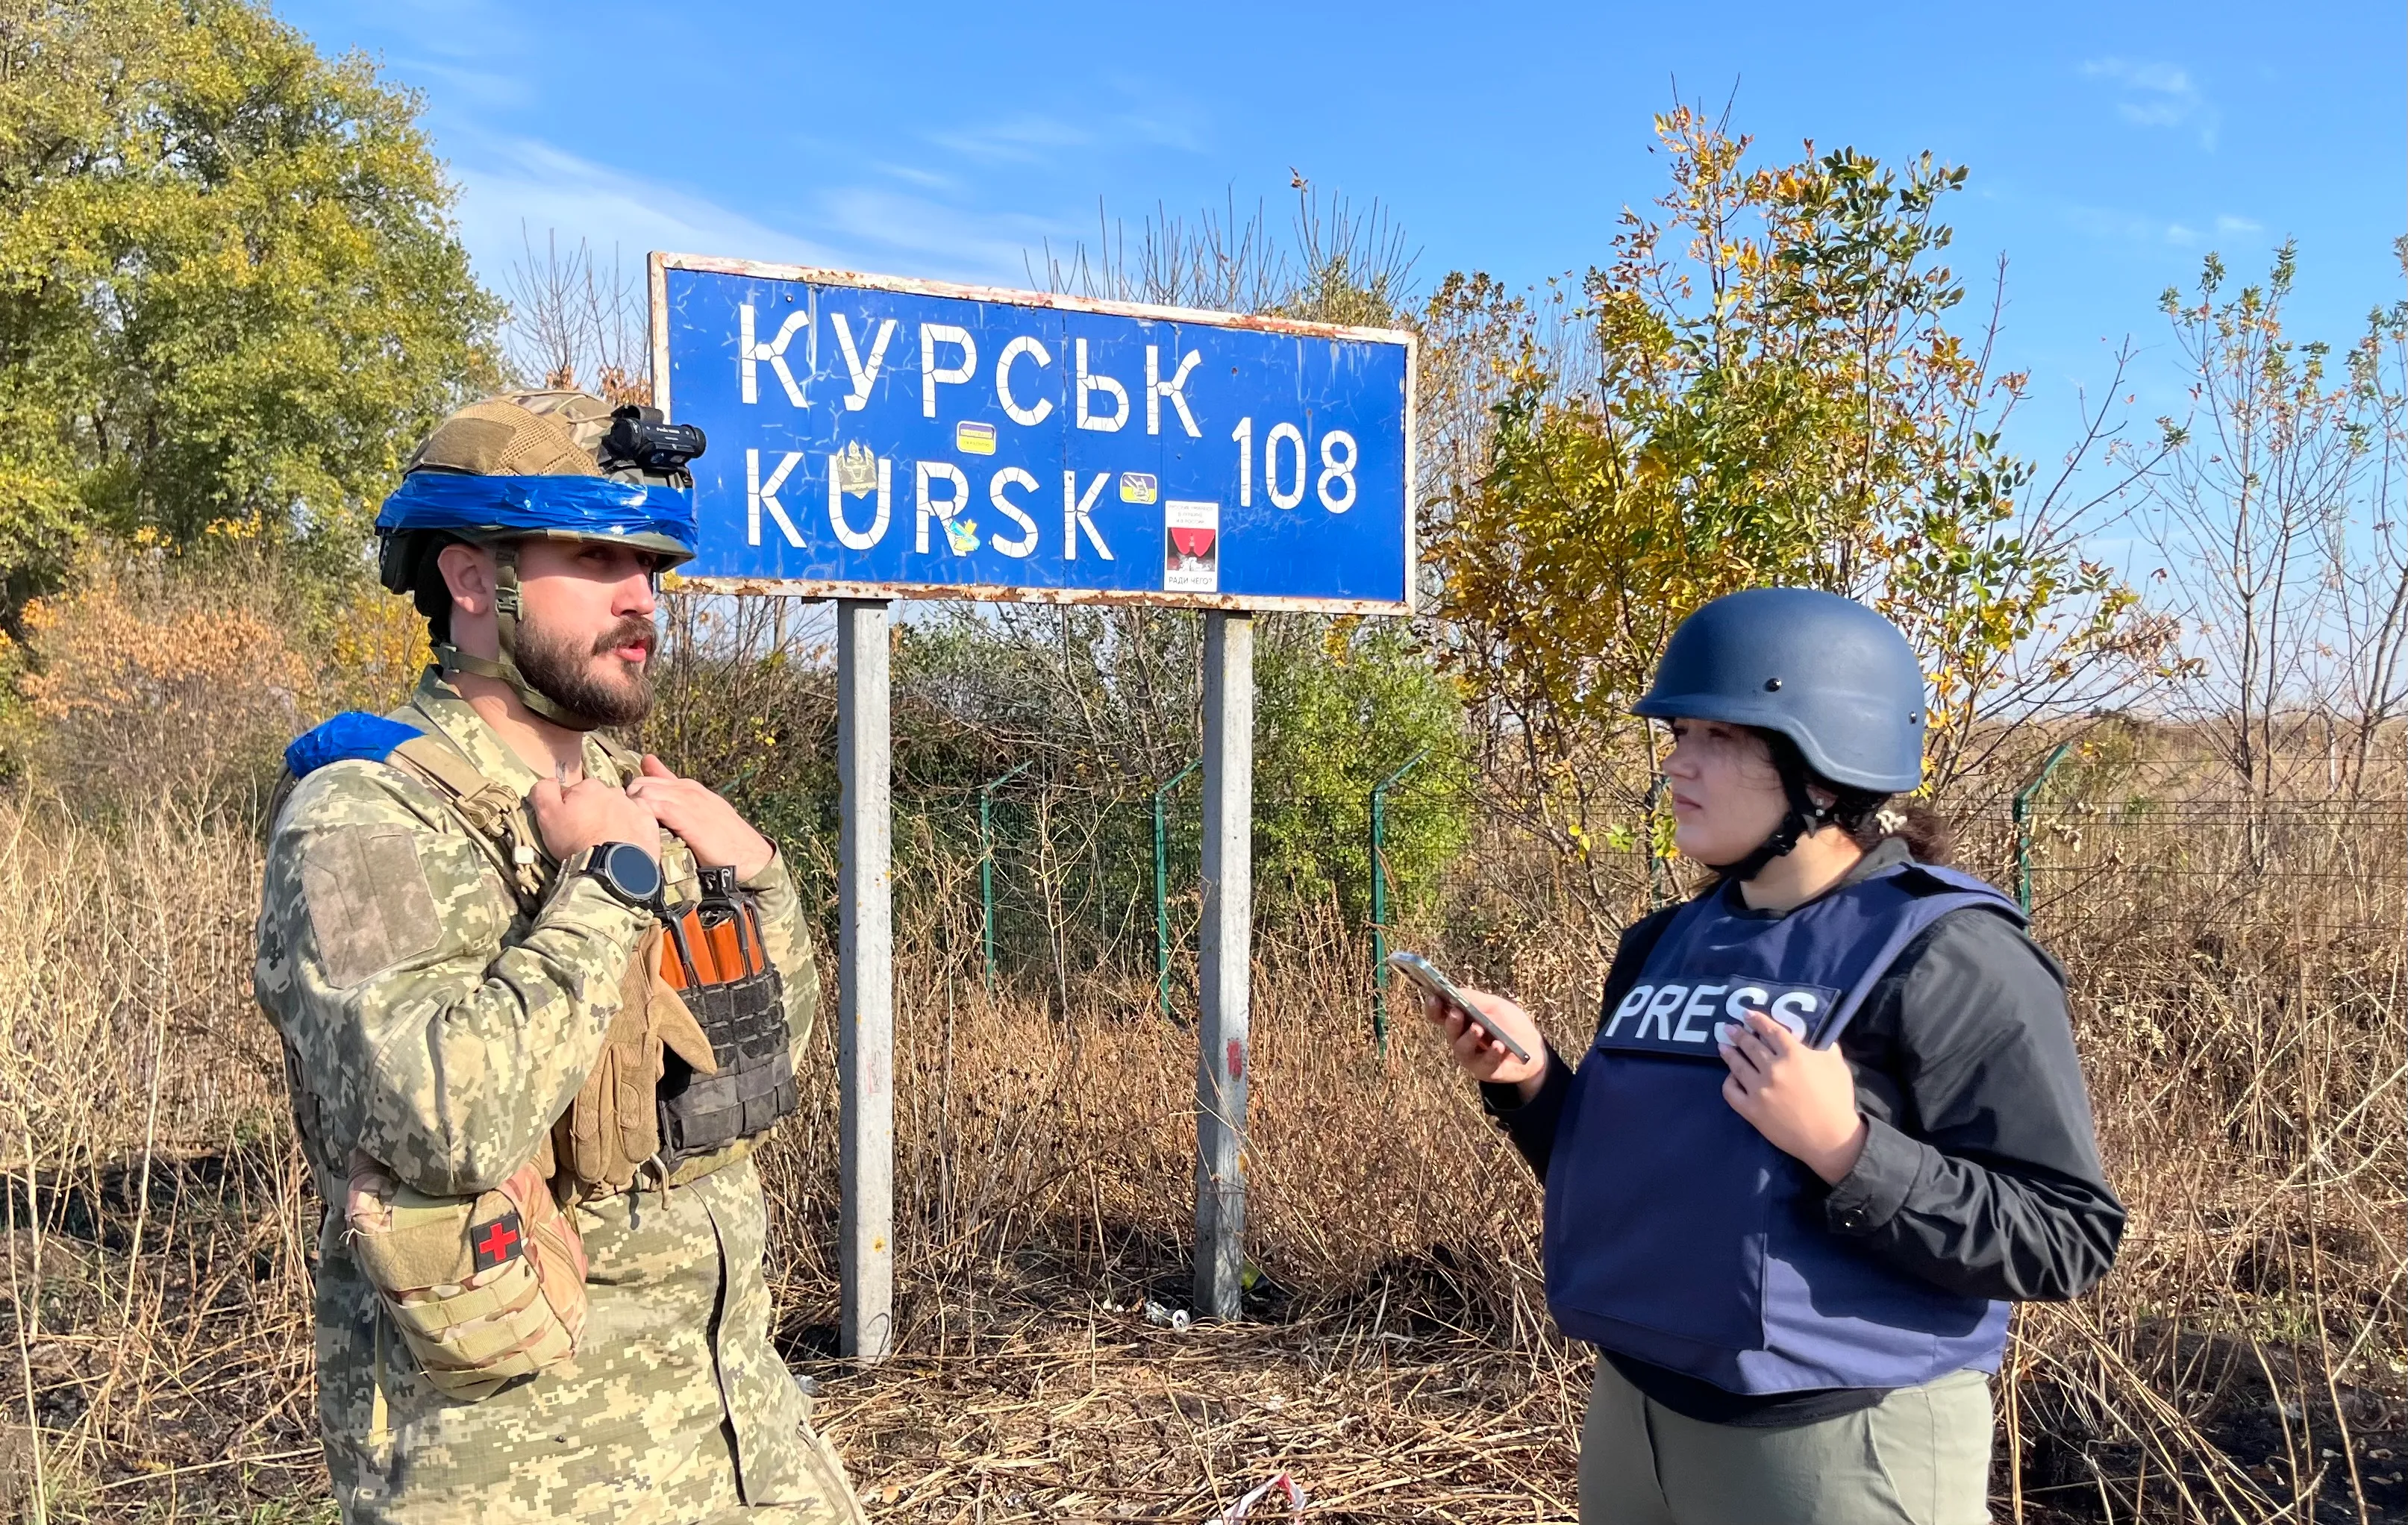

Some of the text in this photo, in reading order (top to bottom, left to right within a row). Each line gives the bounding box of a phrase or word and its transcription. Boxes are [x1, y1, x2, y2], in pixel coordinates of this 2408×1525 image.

[740, 304, 1202, 438] КУРСЬК
[746, 448, 1114, 559] KURSK
[1232, 417, 1357, 514] 108
[1169, 576, 1213, 585] РАДИ ЧЕГО?
[1605, 984, 1818, 1048] PRESS
